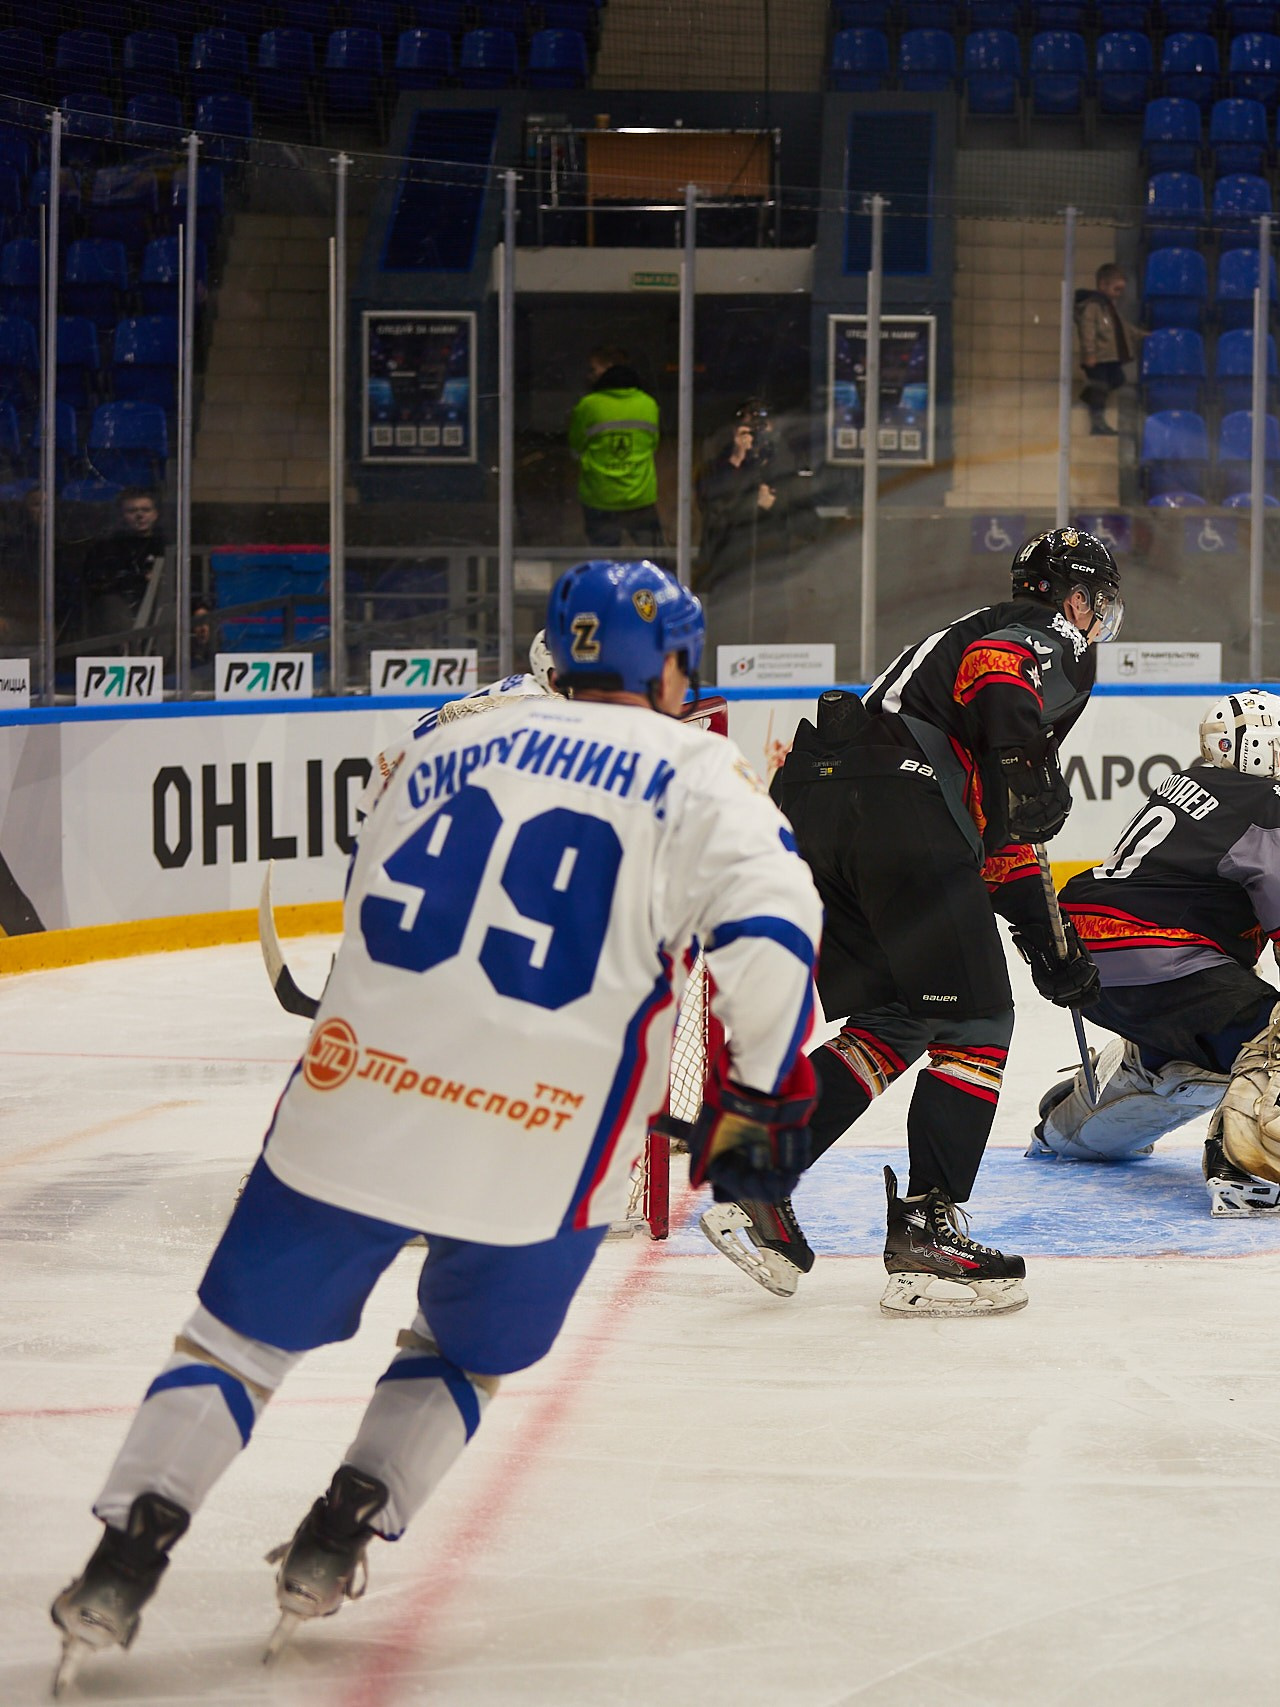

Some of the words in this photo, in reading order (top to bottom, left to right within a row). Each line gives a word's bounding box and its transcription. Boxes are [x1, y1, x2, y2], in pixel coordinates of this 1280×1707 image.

[1071, 563, 1096, 574] CCM
[84, 666, 155, 698] PARI
[224, 662, 303, 692] PARI
[381, 658, 468, 688] PARI
[1001, 756, 1019, 765] CCM
[360, 784, 624, 1011] 99
[922, 994, 958, 1002] BAUER
[535, 1081, 586, 1110] ТТМ
